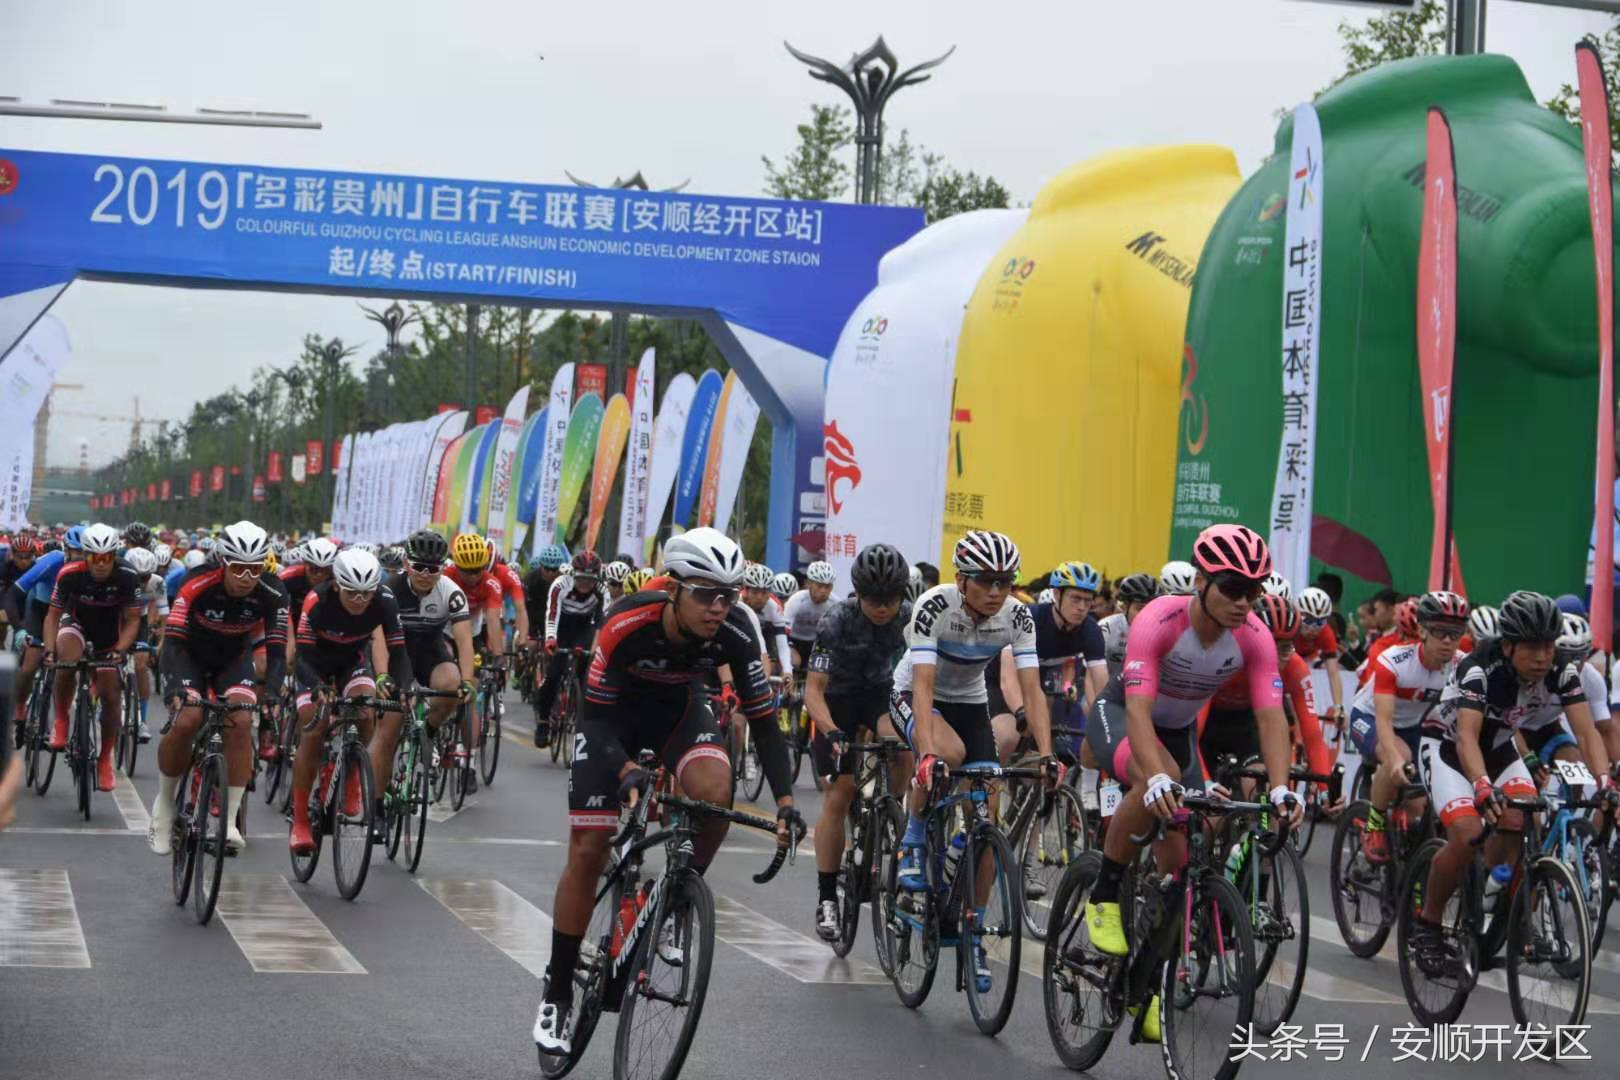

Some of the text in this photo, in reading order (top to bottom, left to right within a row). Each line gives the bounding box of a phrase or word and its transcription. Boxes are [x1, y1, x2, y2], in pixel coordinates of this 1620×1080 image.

[90, 164, 229, 230] 2019
[235, 217, 820, 267] COLOURFUL GUIZHOU CYCLING LEAGUE ANSHUN ECONOMIC DEVELOPMENT ZONE STAION
[914, 594, 949, 637] ZERO
